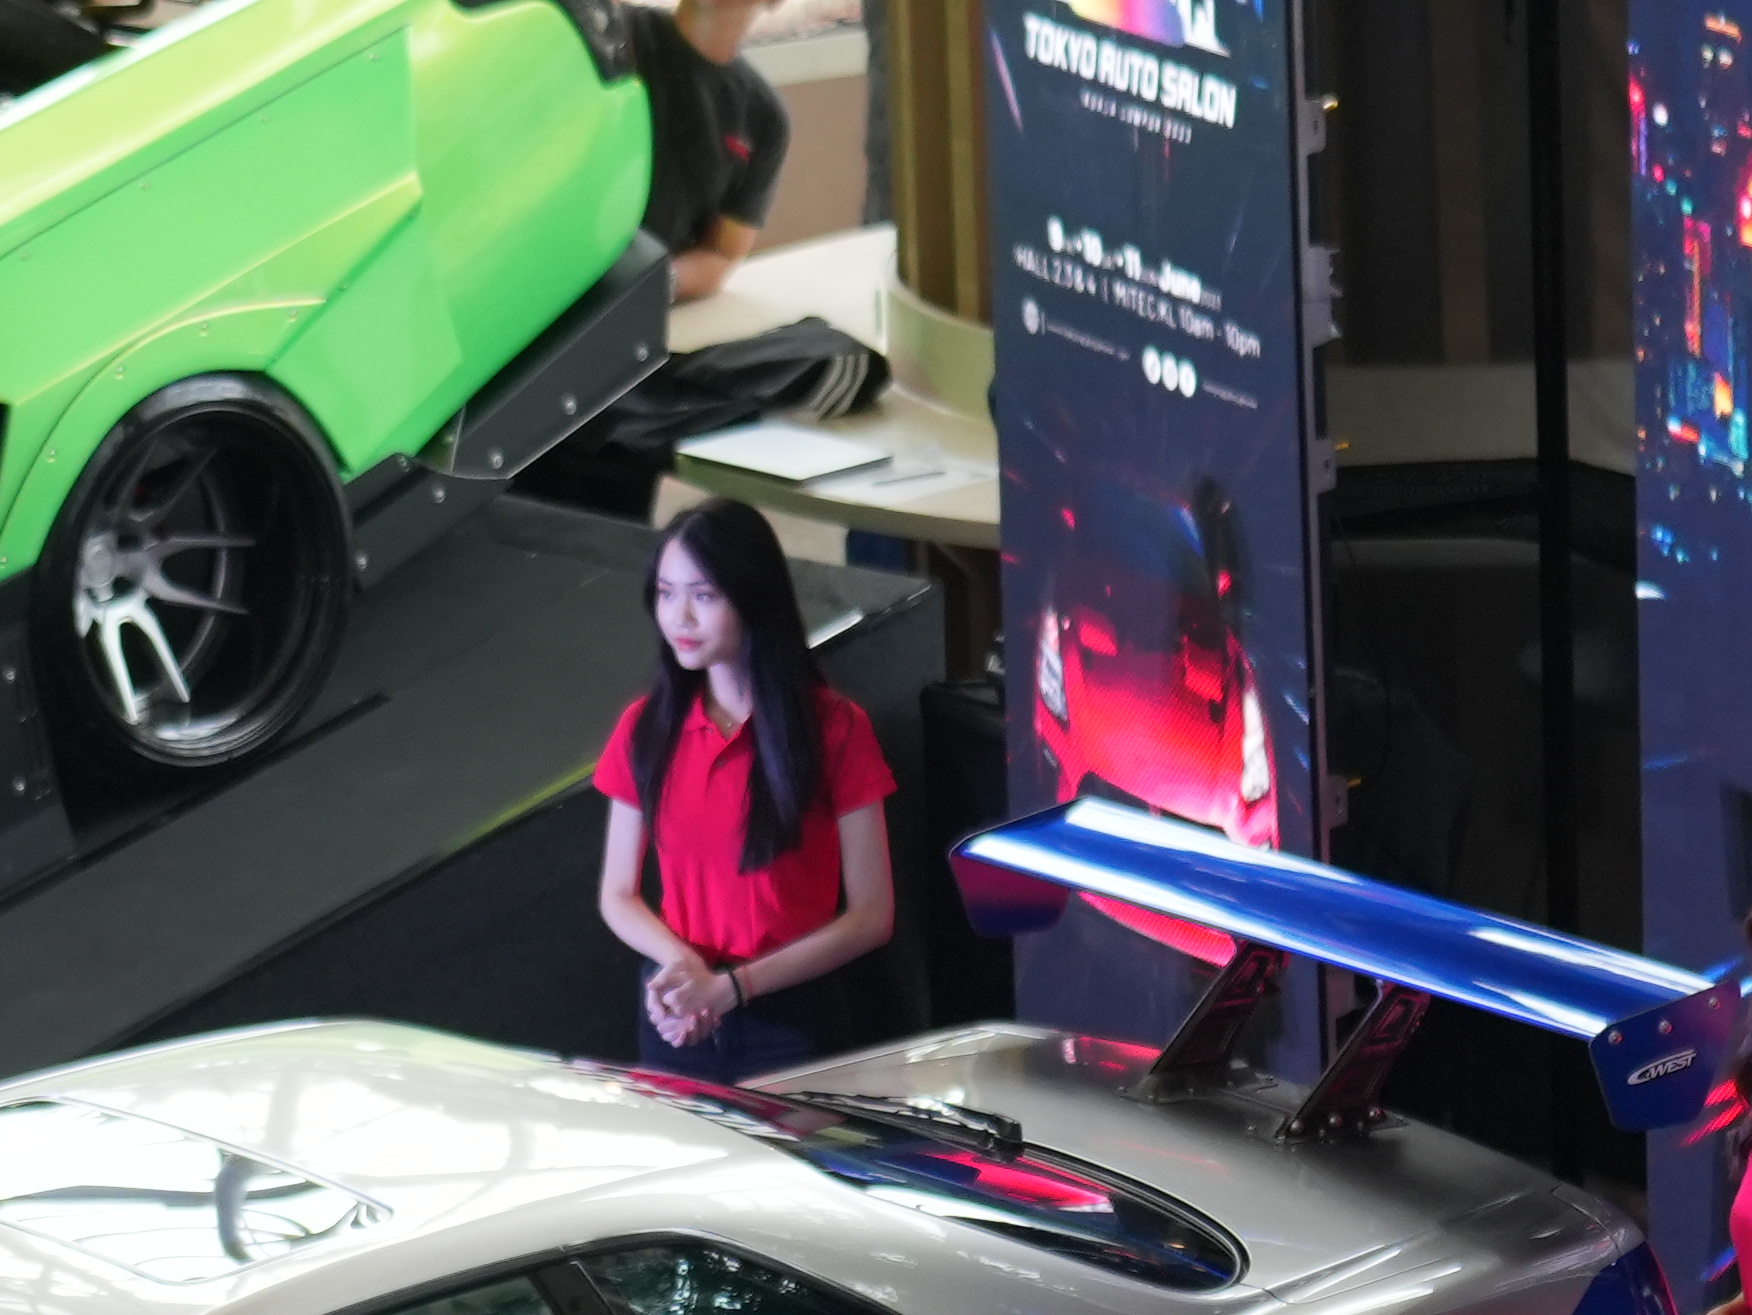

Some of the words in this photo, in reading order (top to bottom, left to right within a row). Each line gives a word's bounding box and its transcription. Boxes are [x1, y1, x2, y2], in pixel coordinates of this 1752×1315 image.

[1023, 11, 1097, 79] TOKYO
[1097, 39, 1160, 101] AUTO
[1160, 59, 1237, 128] SALON
